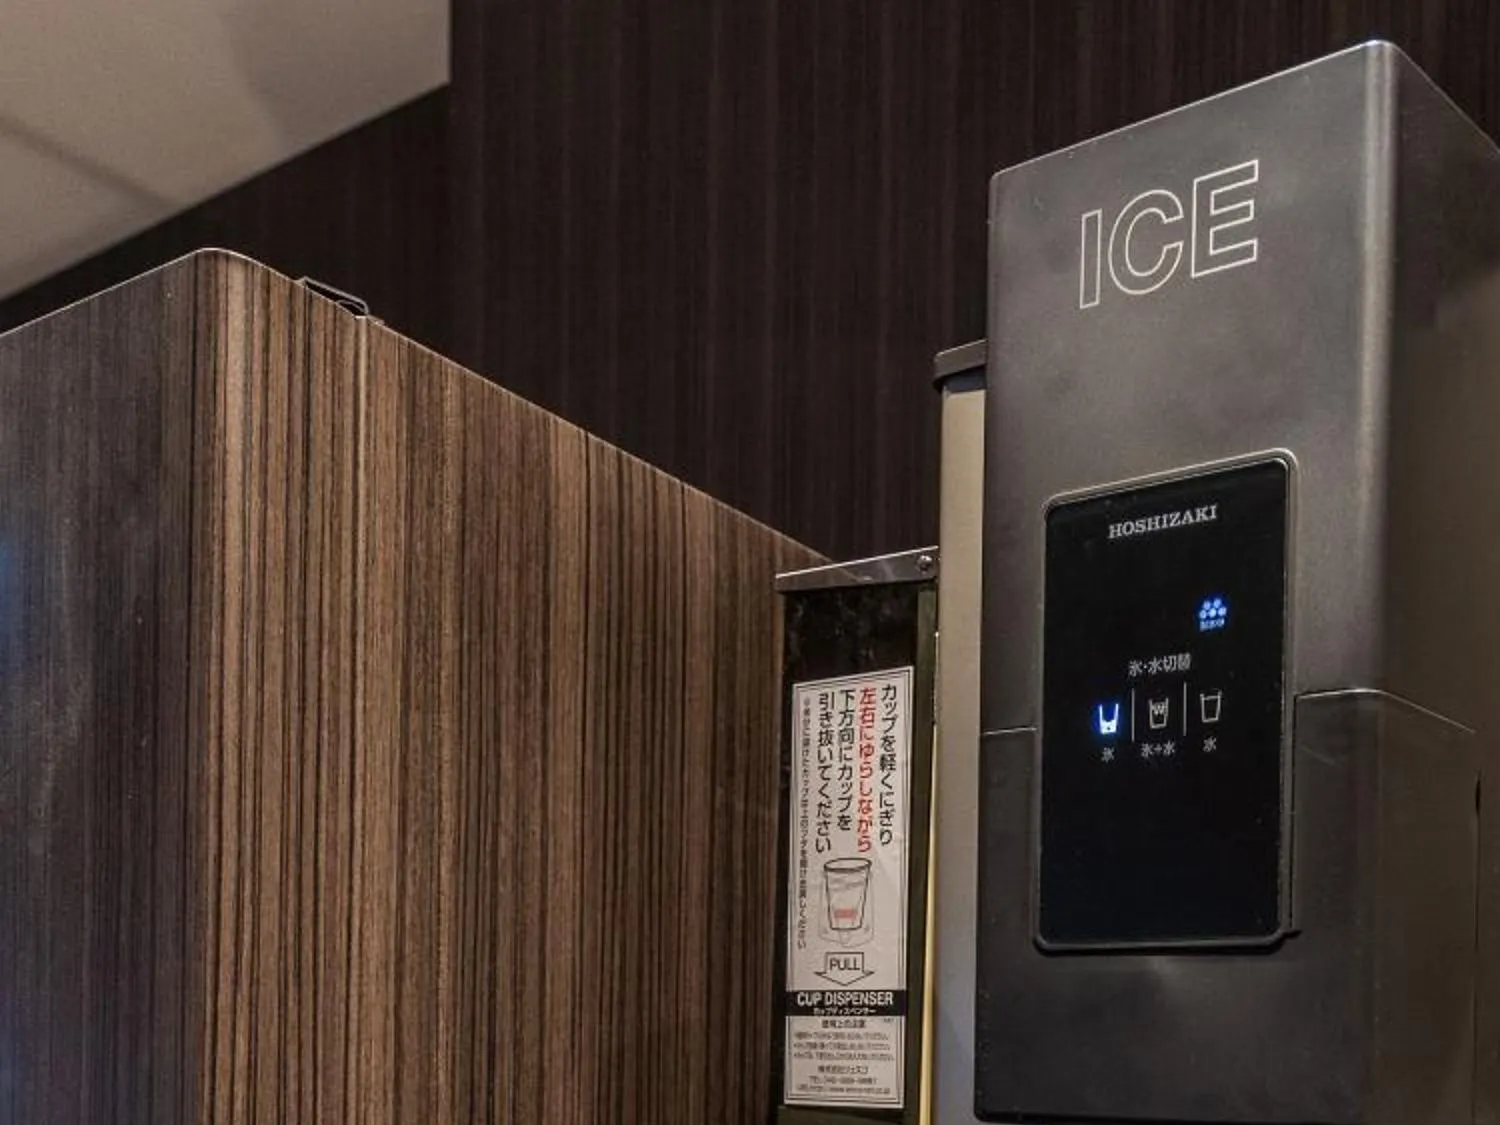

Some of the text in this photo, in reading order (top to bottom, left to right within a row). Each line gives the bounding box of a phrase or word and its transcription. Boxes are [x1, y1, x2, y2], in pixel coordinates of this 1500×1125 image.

[1080, 159, 1258, 309] ICE
[1108, 504, 1218, 539] HOSHIZAKI
[815, 691, 834, 854] 引き抜いてください
[837, 689, 855, 831] 下方向にカップを
[857, 687, 876, 853] 左右にゆらしながら
[797, 991, 894, 1006] CUP DISPENSER
[829, 957, 861, 971] PULL
